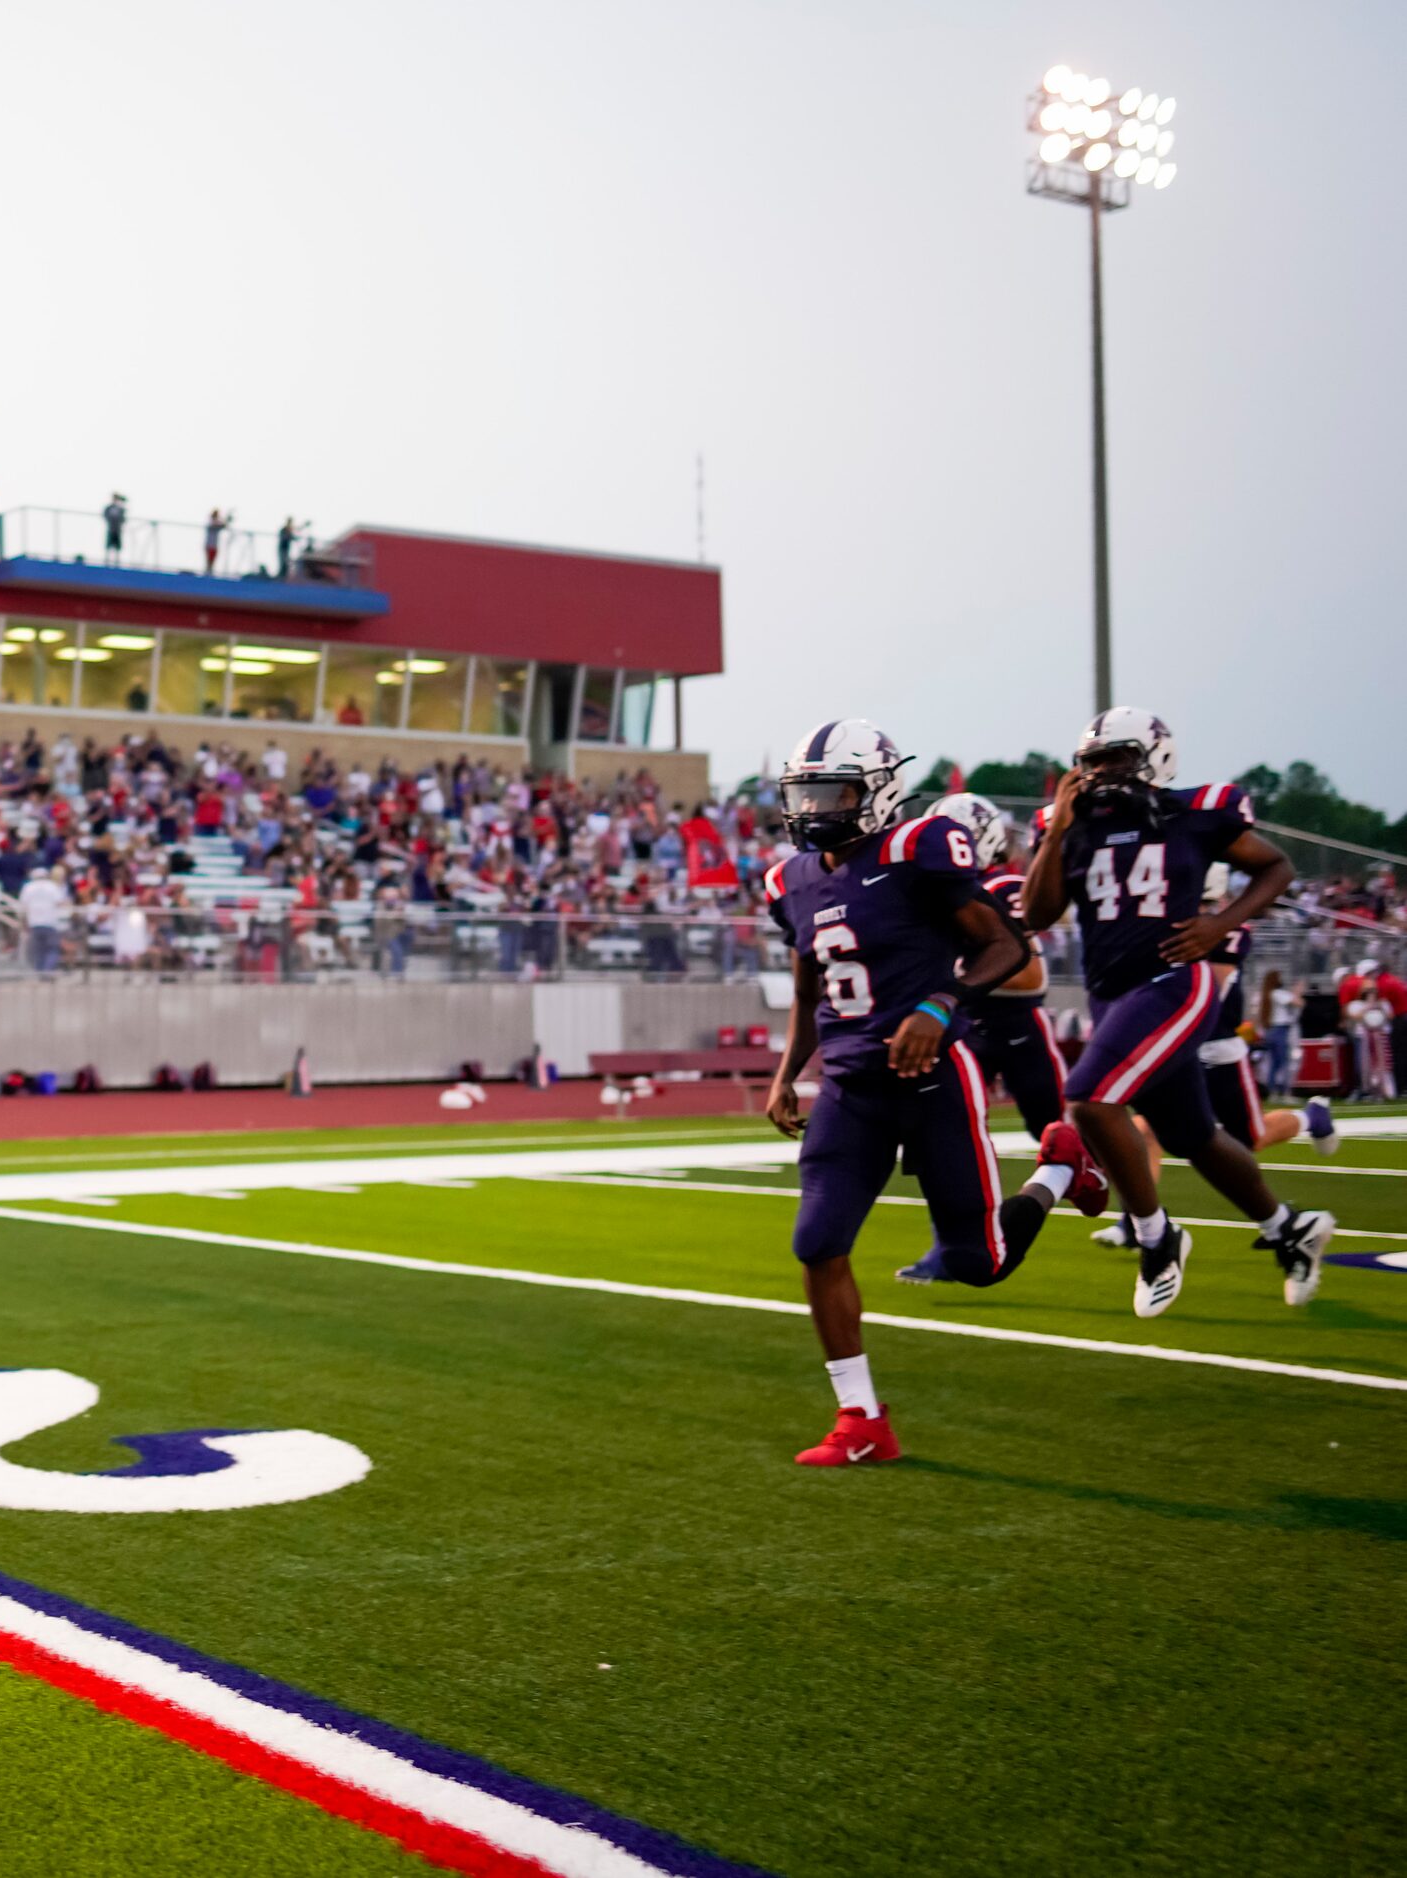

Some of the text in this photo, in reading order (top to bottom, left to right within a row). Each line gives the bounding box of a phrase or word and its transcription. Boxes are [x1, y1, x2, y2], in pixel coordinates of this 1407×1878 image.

[948, 830, 973, 867] 6
[1085, 842, 1169, 921] 44
[813, 924, 875, 1017] 6
